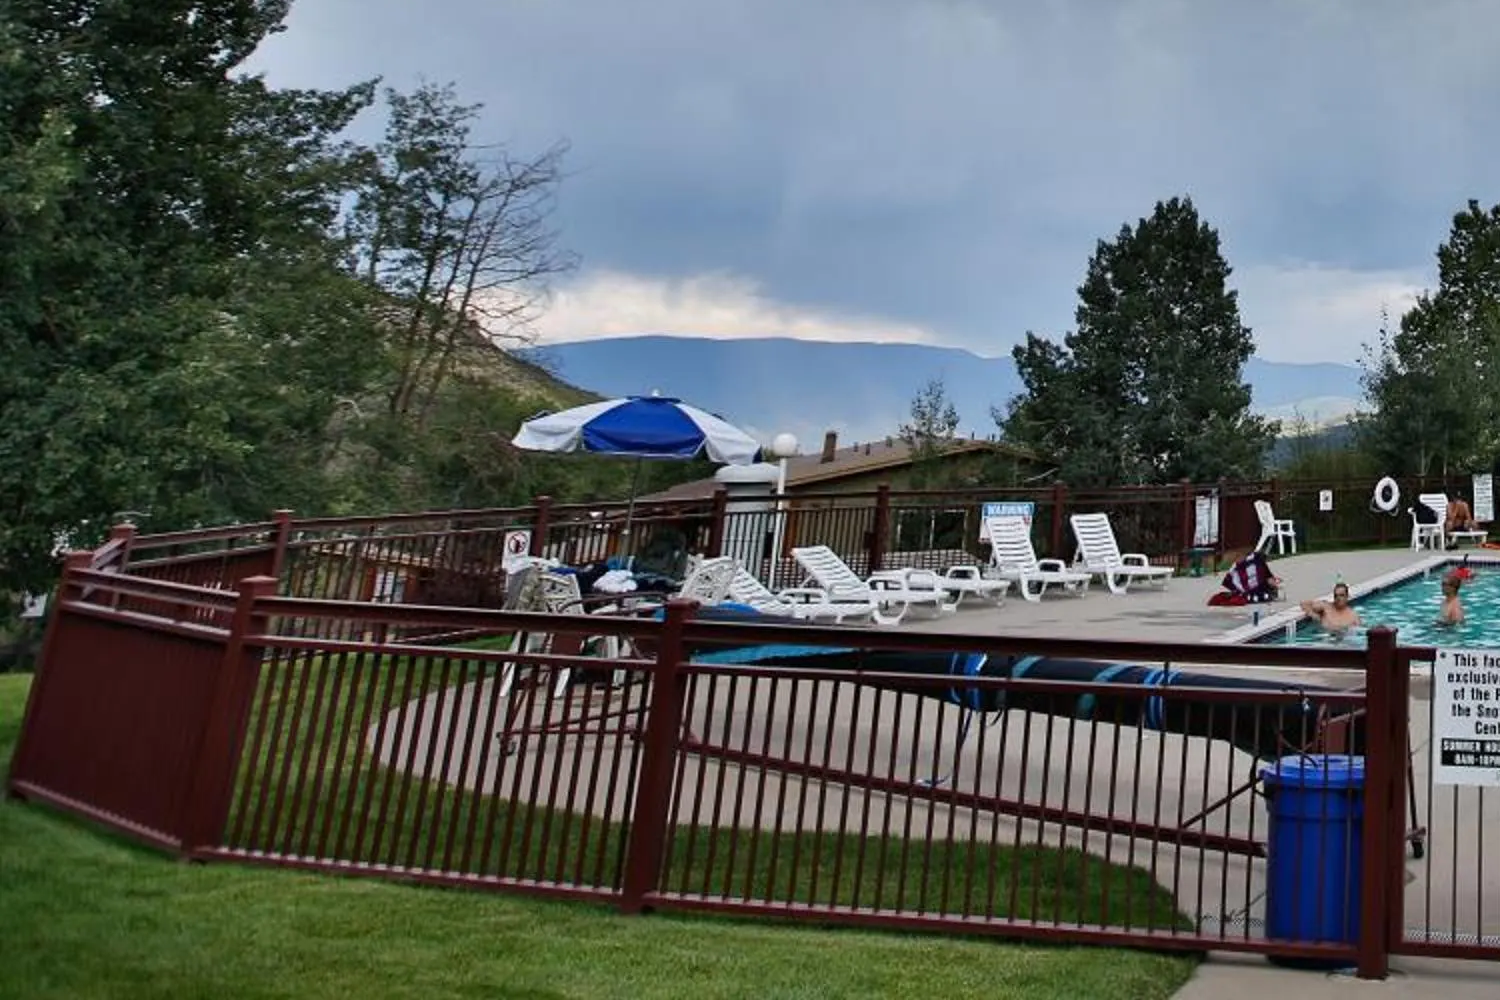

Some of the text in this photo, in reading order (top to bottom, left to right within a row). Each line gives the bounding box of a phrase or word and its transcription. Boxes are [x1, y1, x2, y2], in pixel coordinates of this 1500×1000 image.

[1454, 653, 1478, 667] This
[1453, 687, 1465, 701] of
[1471, 687, 1490, 701] the
[1452, 704, 1471, 717] the
